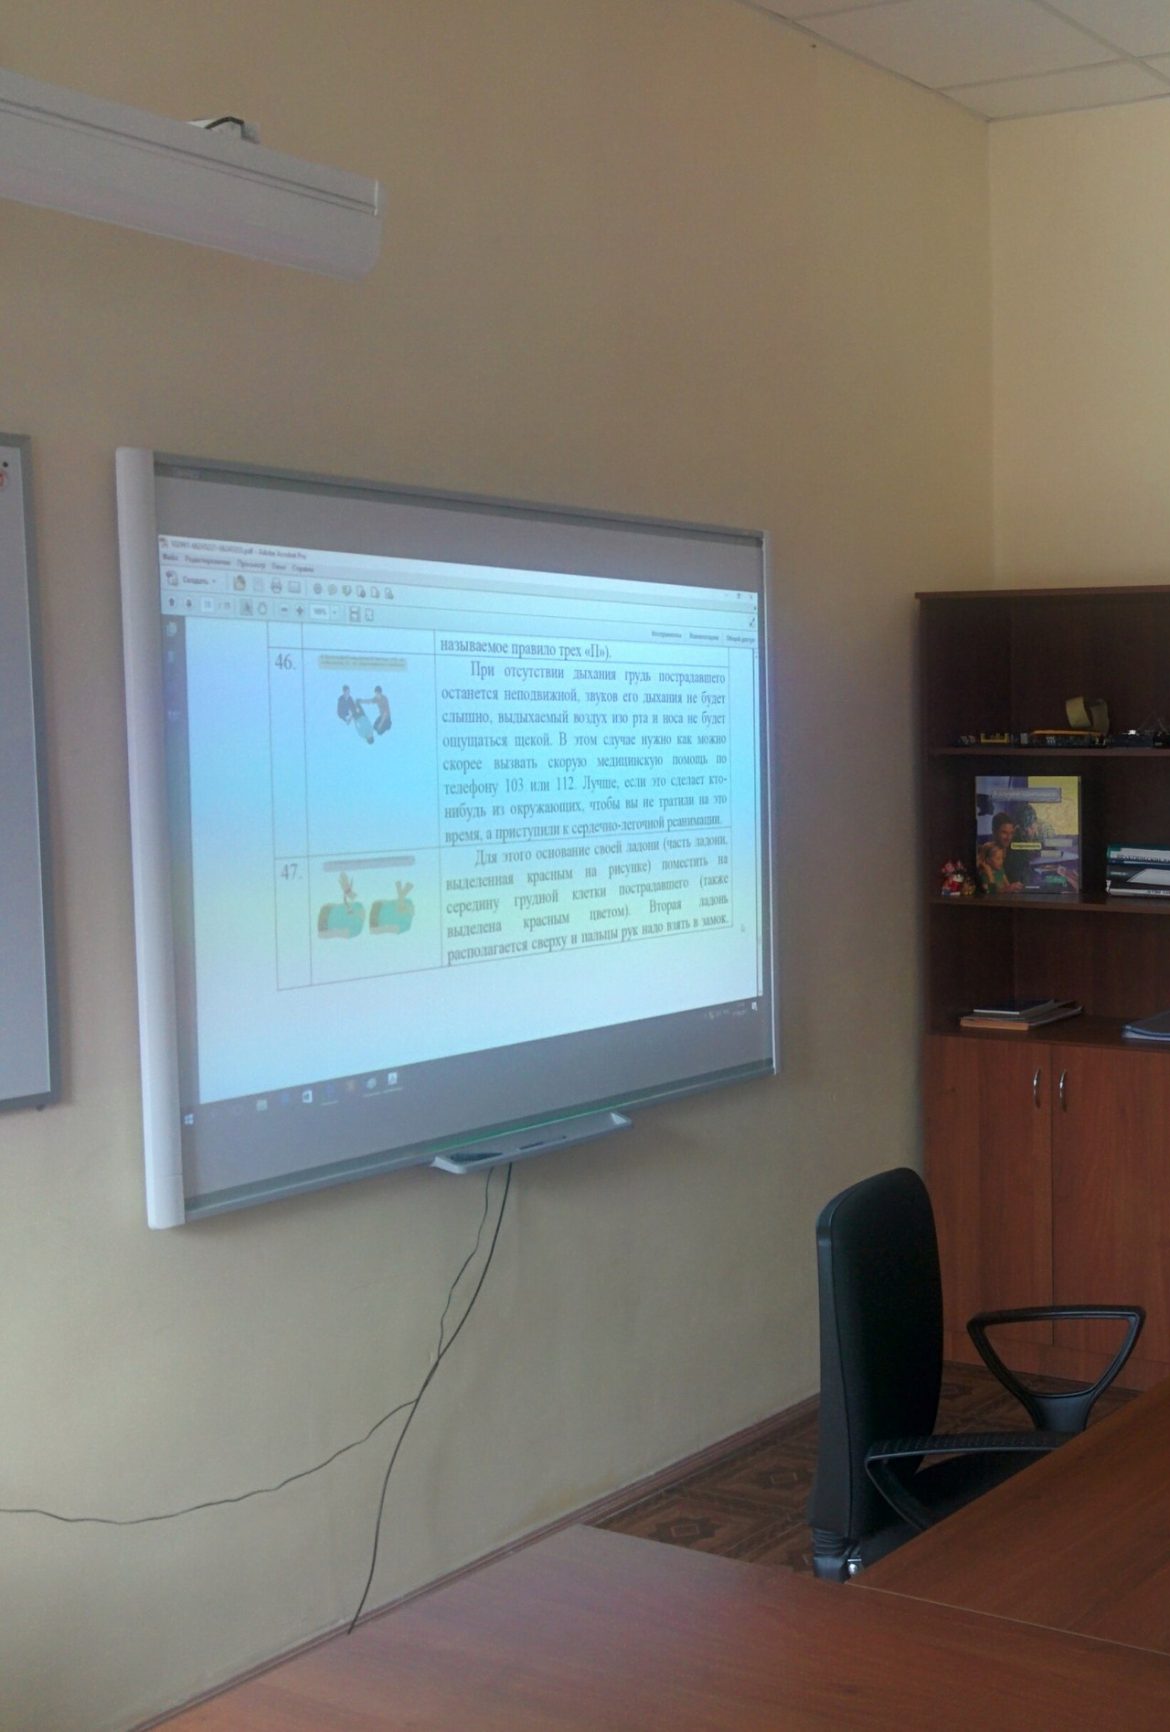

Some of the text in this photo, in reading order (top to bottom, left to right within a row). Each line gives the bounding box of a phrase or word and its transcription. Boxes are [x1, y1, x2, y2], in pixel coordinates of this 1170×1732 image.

[275, 653, 296, 670] 46.
[440, 641, 508, 654] называемое
[511, 644, 556, 658] правило
[559, 646, 582, 660] трех
[471, 662, 725, 686] При отсутствии дыхания грудь пострадавшего
[441, 689, 498, 699] останется
[585, 691, 618, 704] звуков
[622, 691, 638, 702] его
[642, 692, 682, 703] дыхания
[686, 692, 697, 702] не
[700, 688, 725, 706] будет
[498, 709, 569, 725] выдыхаемый
[573, 713, 607, 727] воздух
[611, 714, 628, 724] изо
[632, 714, 648, 727] рта
[652, 714, 658, 724] и
[662, 714, 683, 724] носа
[687, 714, 698, 724] не
[701, 710, 725, 728] будет
[442, 735, 508, 749] ощущаться
[559, 731, 567, 745] В
[574, 735, 597, 745] этом
[602, 735, 636, 748] случае
[641, 735, 671, 748] нужно
[676, 734, 692, 744] как
[697, 734, 726, 744] можно
[442, 754, 727, 772] скорее вызвать скорую медицинскую помощь по
[444, 780, 499, 796] телефону
[506, 777, 524, 792] 103
[530, 781, 550, 791] или
[624, 777, 646, 788] если
[652, 777, 666, 787] это
[670, 776, 704, 788] сделает
[708, 775, 727, 785] кто-
[444, 803, 486, 820] нибудь
[492, 805, 505, 815] из
[589, 795, 620, 810] чтобы
[625, 798, 638, 809] вы
[642, 797, 654, 808] не
[658, 795, 694, 810] тратили
[698, 795, 709, 805] на
[713, 794, 727, 804] это
[485, 829, 492, 839] а
[495, 825, 560, 842] приступили
[562, 824, 569, 834] к
[571, 814, 664, 837] сердечно-легочной
[474, 849, 497, 866] Для
[502, 850, 532, 862] этого
[535, 845, 590, 859] основание
[593, 839, 622, 855] своей
[625, 840, 659, 853] ладони
[662, 836, 691, 853] (часть
[280, 863, 302, 880] 47.
[446, 854, 728, 890] выделенная красным на рисунке) поместить на
[446, 873, 728, 914] середину грудной клетки пострадавшего (также
[447, 920, 502, 936] выделена
[523, 912, 569, 930] красным
[649, 898, 682, 915] Вторая
[698, 894, 728, 908] ладонь
[447, 940, 528, 963] располагается
[531, 935, 567, 950] сверху
[570, 933, 577, 944] и
[581, 928, 618, 942] пальцы
[620, 925, 638, 941] рук
[641, 922, 663, 935] надо
[666, 919, 690, 932] взять
[692, 918, 698, 928] в
